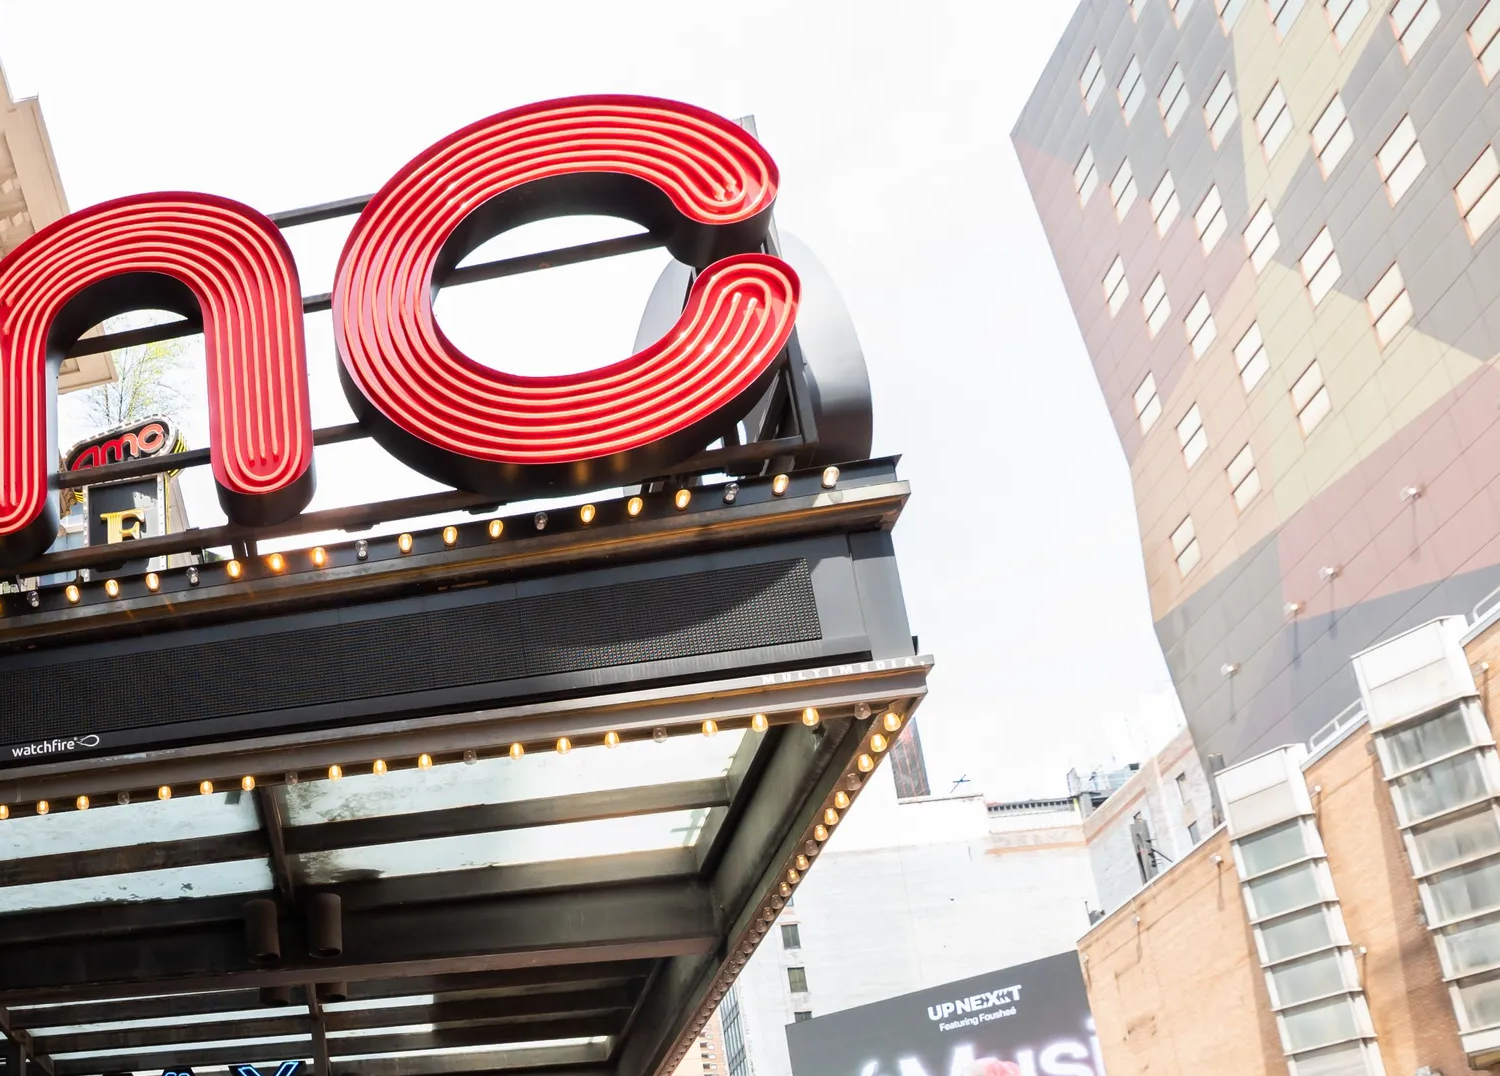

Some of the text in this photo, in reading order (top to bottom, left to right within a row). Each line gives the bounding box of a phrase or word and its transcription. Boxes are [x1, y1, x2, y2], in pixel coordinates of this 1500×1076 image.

[70, 422, 165, 472] amc
[11, 738, 76, 758] watchfire
[939, 1016, 979, 1031] Featuring
